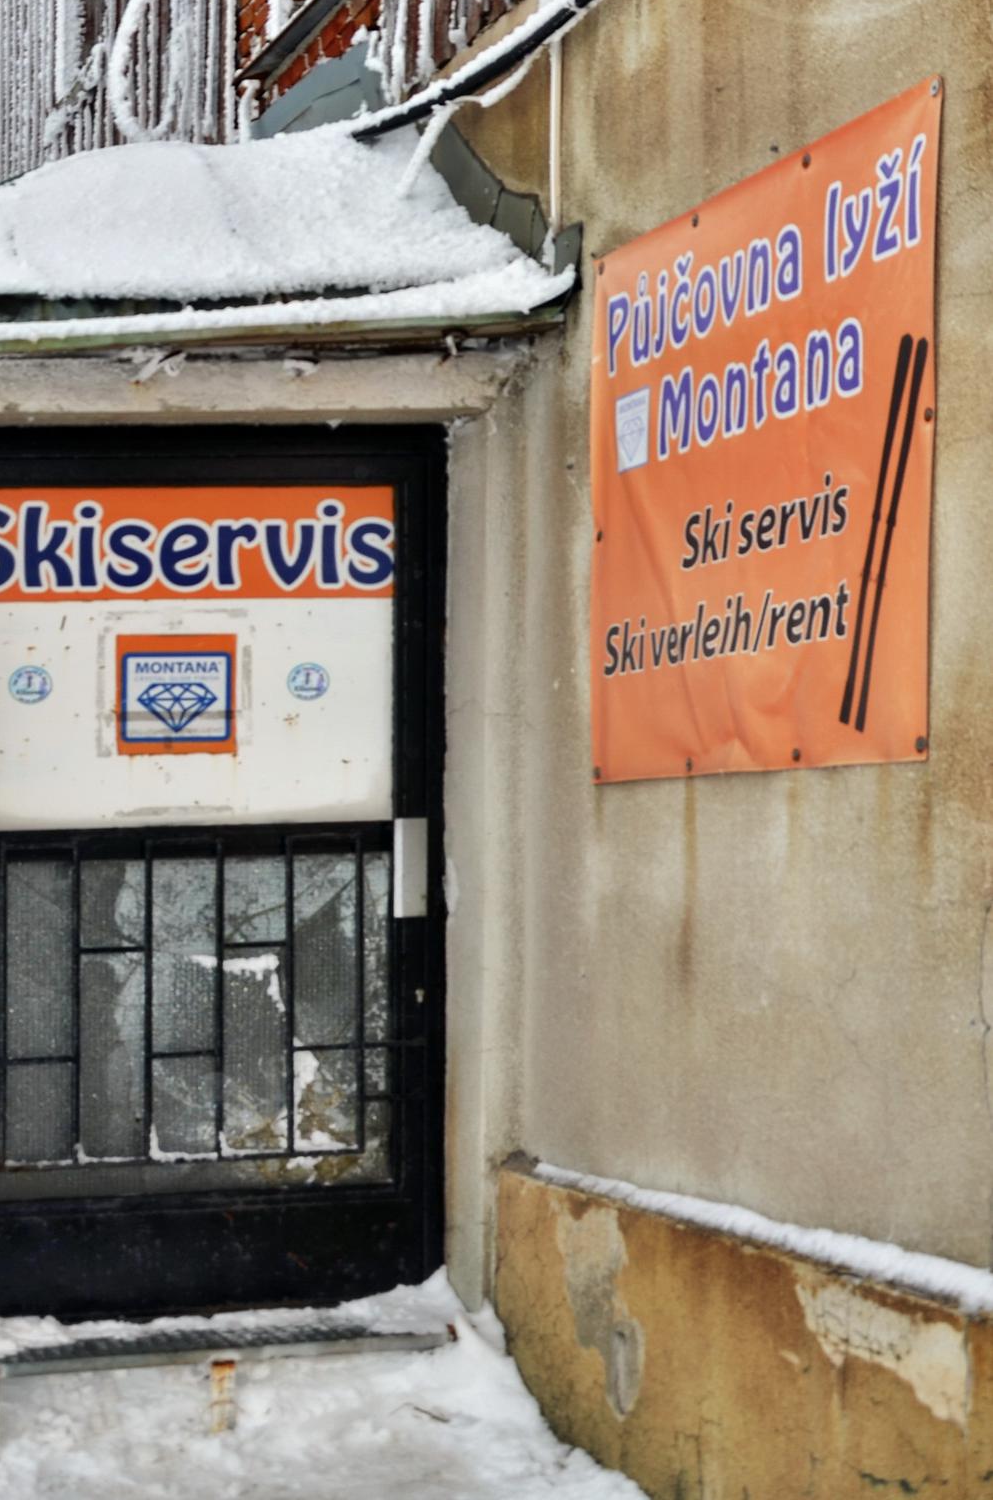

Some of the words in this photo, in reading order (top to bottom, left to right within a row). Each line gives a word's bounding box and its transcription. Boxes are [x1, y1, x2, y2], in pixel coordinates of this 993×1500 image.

[607, 223, 802, 377] Půjčovna
[824, 135, 926, 282] lyží
[657, 317, 863, 460] Montana
[681, 500, 733, 571] Ski
[737, 471, 850, 555] servis
[135, 661, 219, 674] MONTANA
[603, 617, 646, 676] Ski
[650, 578, 850, 668] verleih/rent
